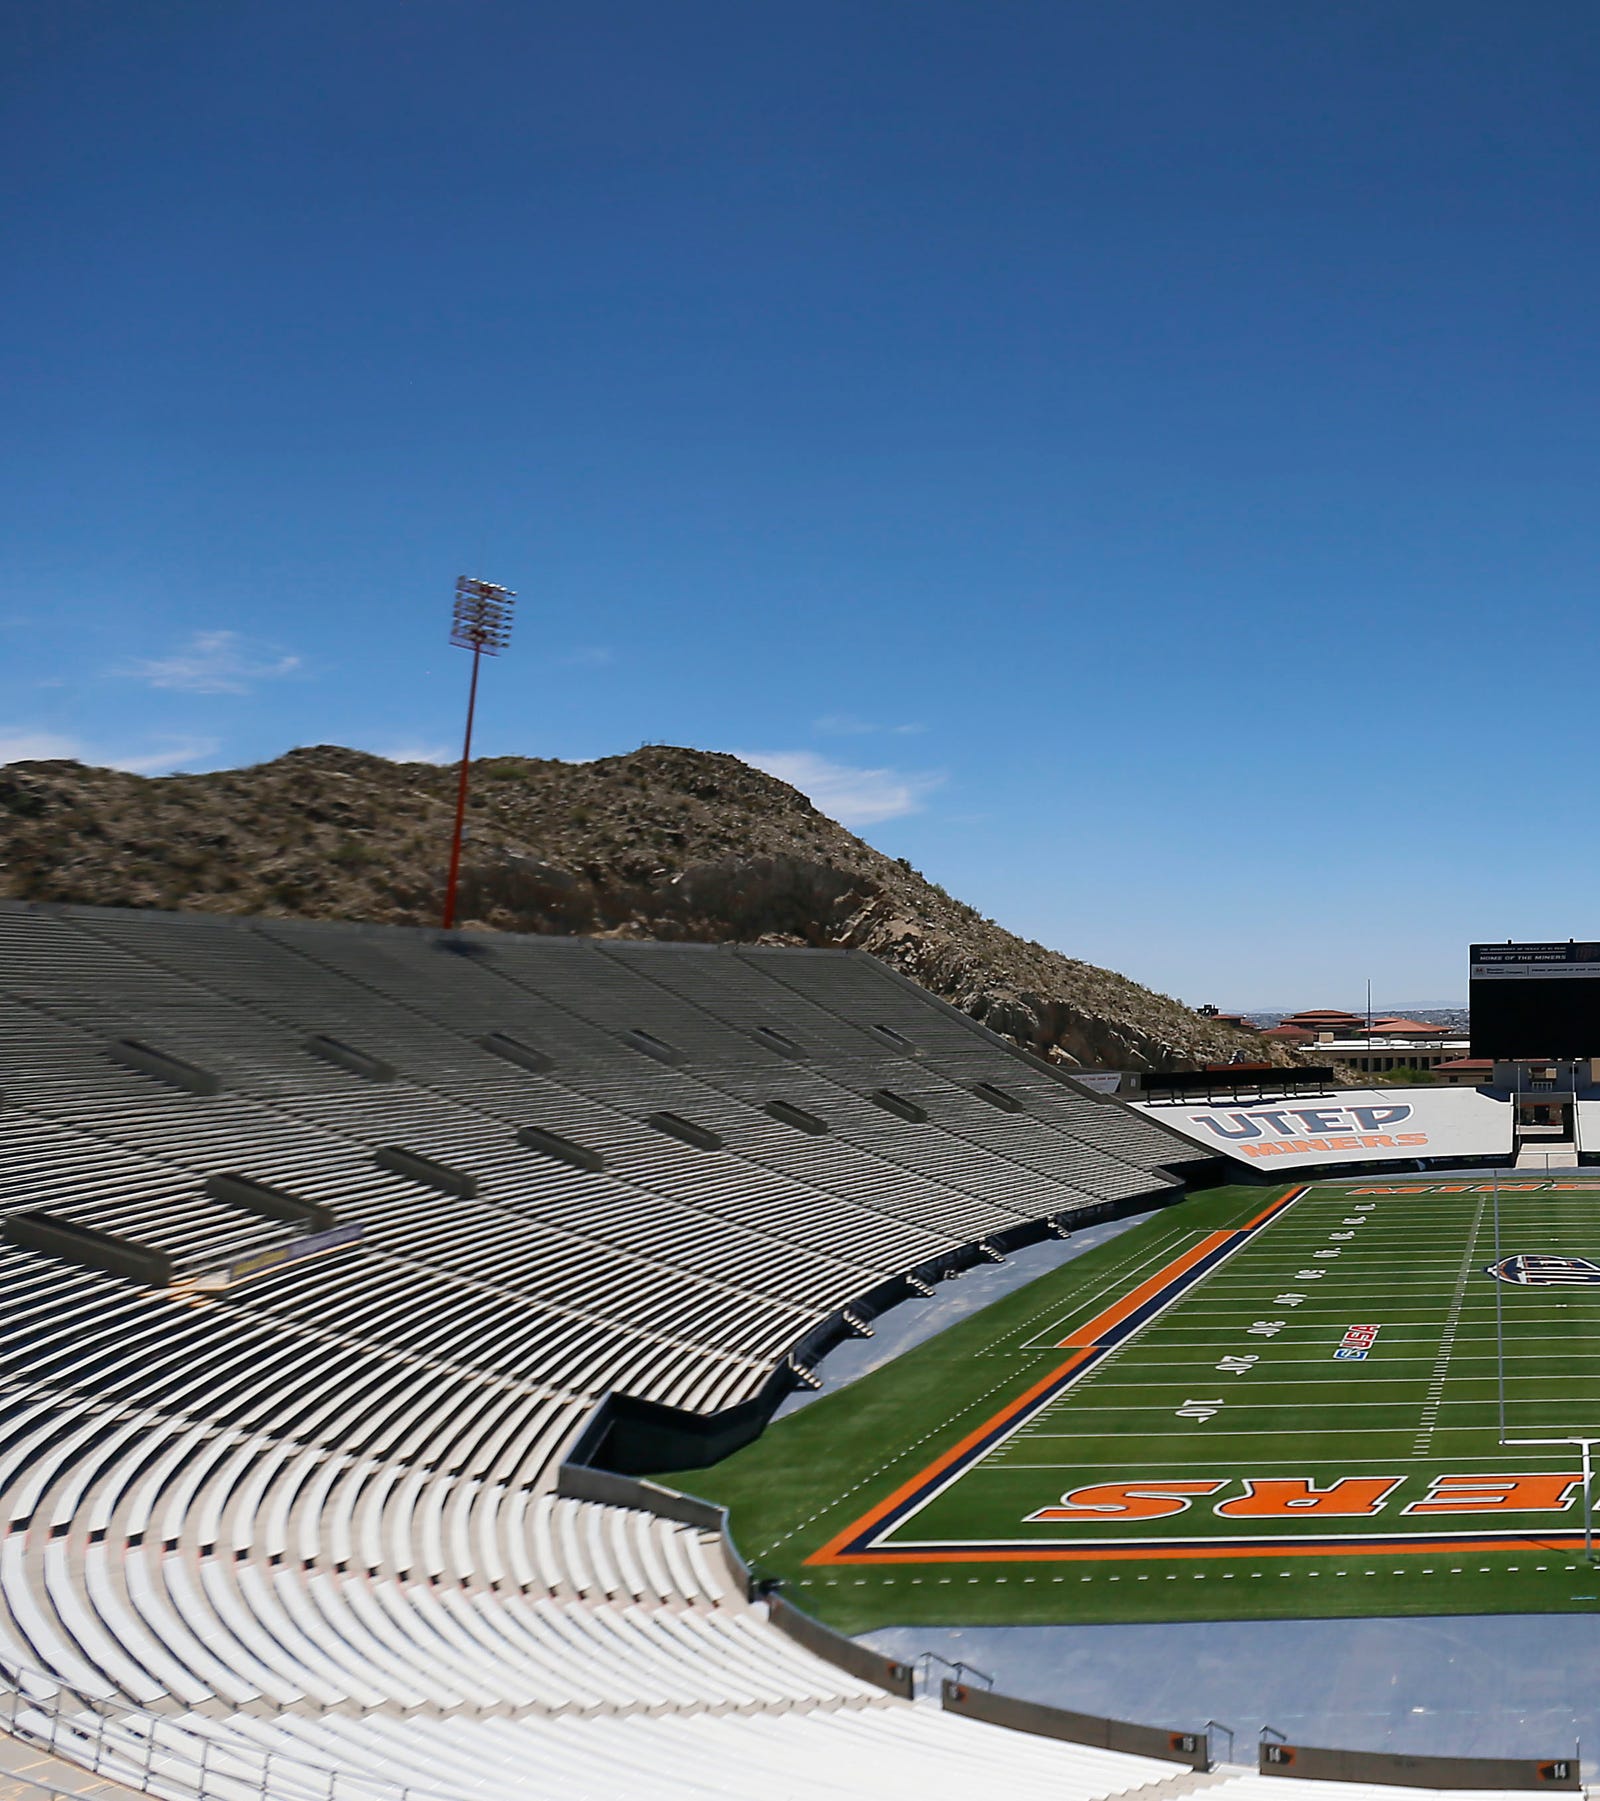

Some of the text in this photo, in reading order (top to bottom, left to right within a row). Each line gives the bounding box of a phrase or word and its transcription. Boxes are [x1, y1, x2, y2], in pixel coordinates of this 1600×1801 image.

[1187, 1103, 1414, 1141] UTEP
[1238, 1133, 1429, 1158] MINERS
[1215, 1354, 1260, 1371] 20
[1174, 1398, 1225, 1417] 10
[1269, 1746, 1281, 1763] 14
[1553, 1763, 1567, 1779] 14
